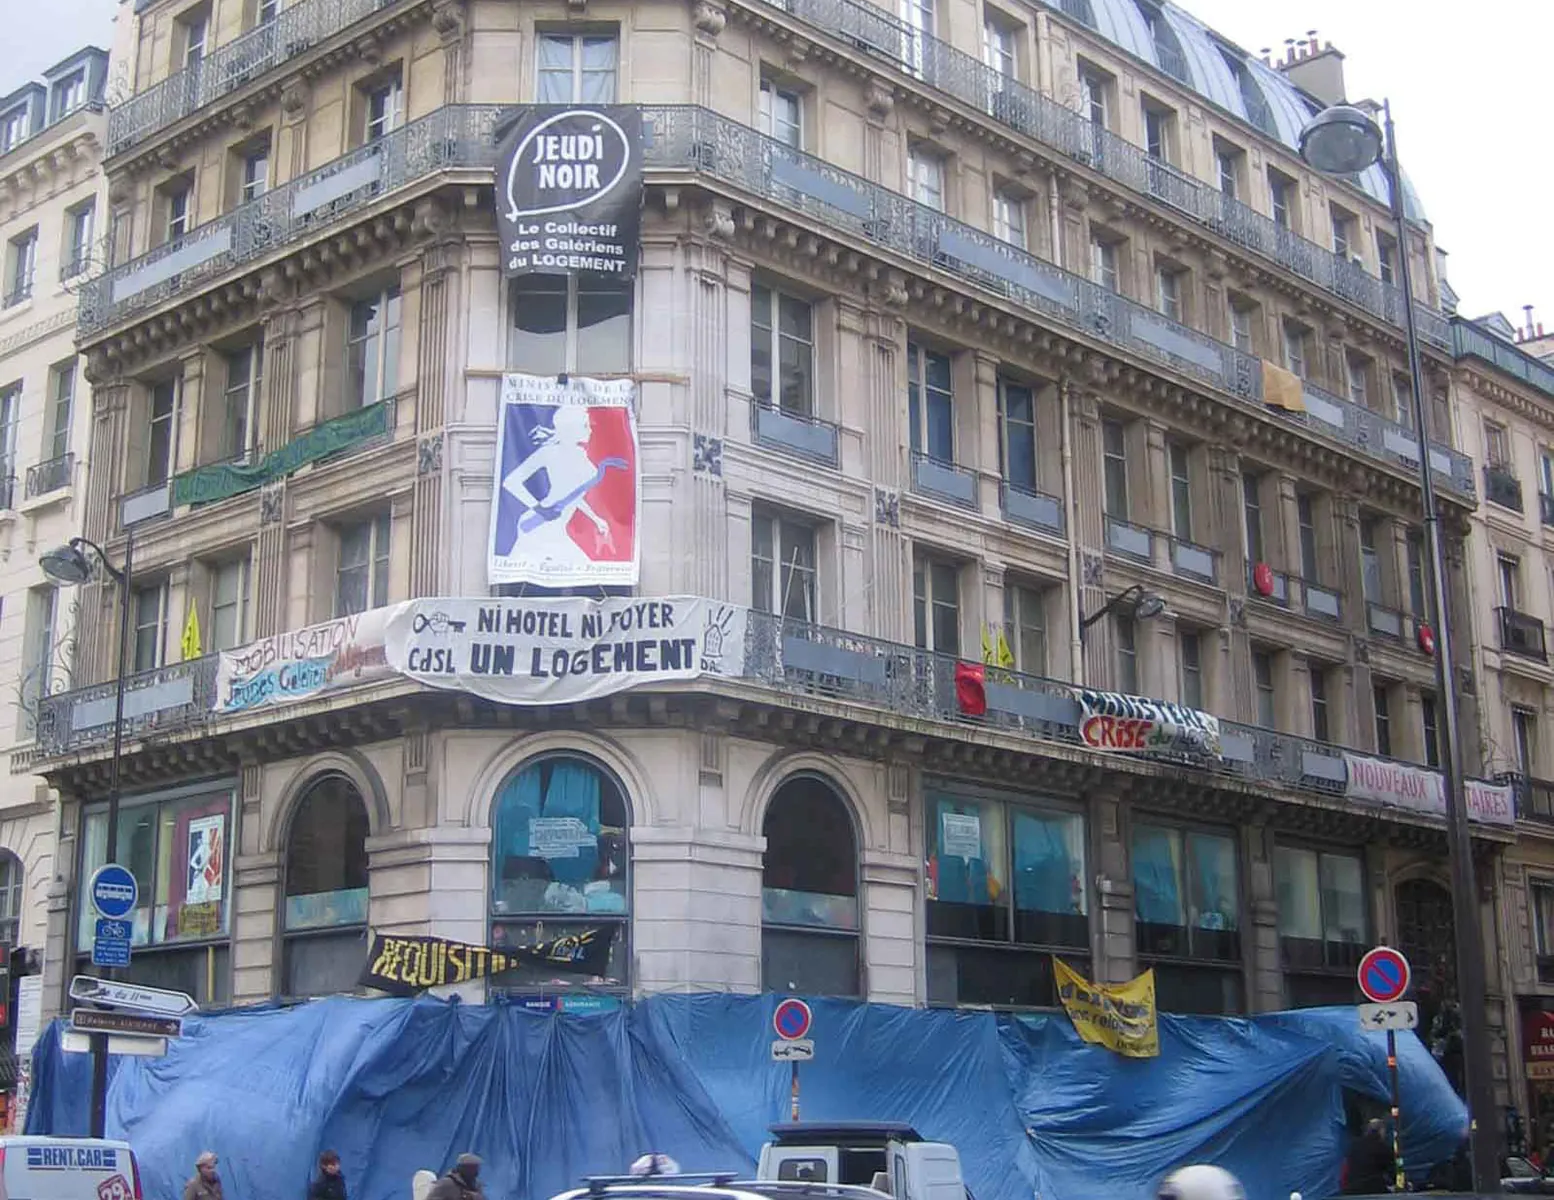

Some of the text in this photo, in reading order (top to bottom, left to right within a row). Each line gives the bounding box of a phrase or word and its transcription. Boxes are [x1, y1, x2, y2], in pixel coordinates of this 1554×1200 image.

[539, 164, 601, 189] NOIR
[518, 222, 617, 237] Le Collectif
[510, 238, 623, 255] des Galériens
[508, 254, 626, 272] du LOGEMENT
[506, 608, 572, 638] HOTEL
[470, 643, 515, 675] UN
[531, 638, 696, 678] LOGEMENT
[1352, 763, 1427, 799] NOUVEAUX
[43, 1147, 73, 1166] RENT
[78, 1148, 102, 1167] CAR
